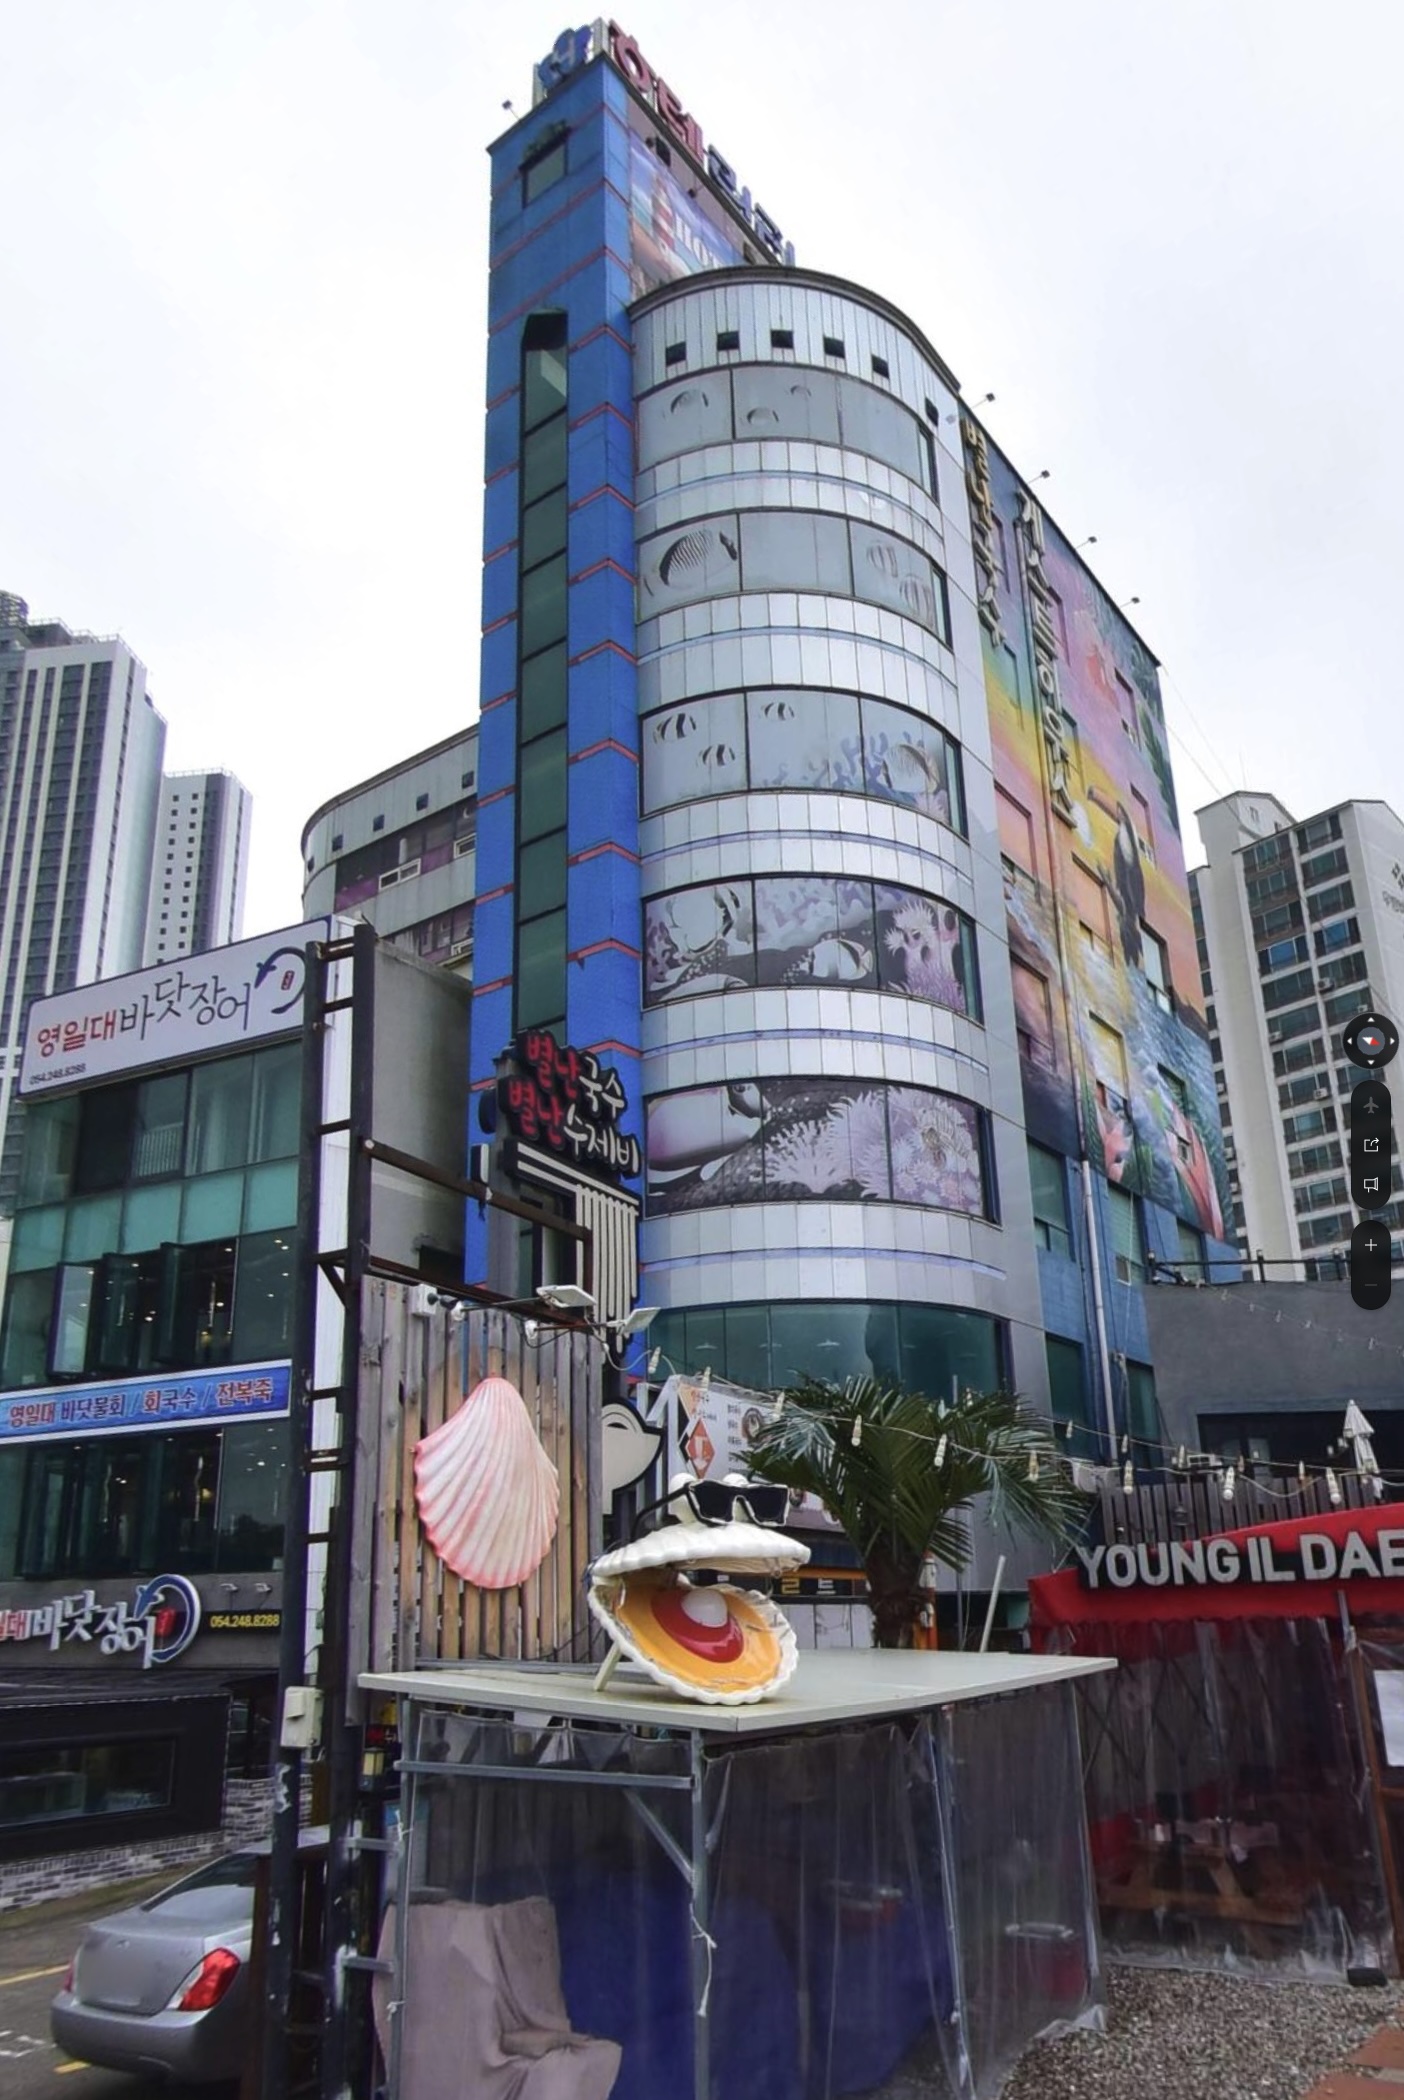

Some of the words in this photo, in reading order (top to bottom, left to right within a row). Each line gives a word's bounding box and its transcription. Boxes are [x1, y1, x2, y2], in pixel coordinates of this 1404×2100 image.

[10, 1402, 56, 1429] 영일대
[61, 1394, 127, 1422] 바닷물회
[143, 1387, 197, 1414] 회국수
[217, 1377, 274, 1407] 전복죽
